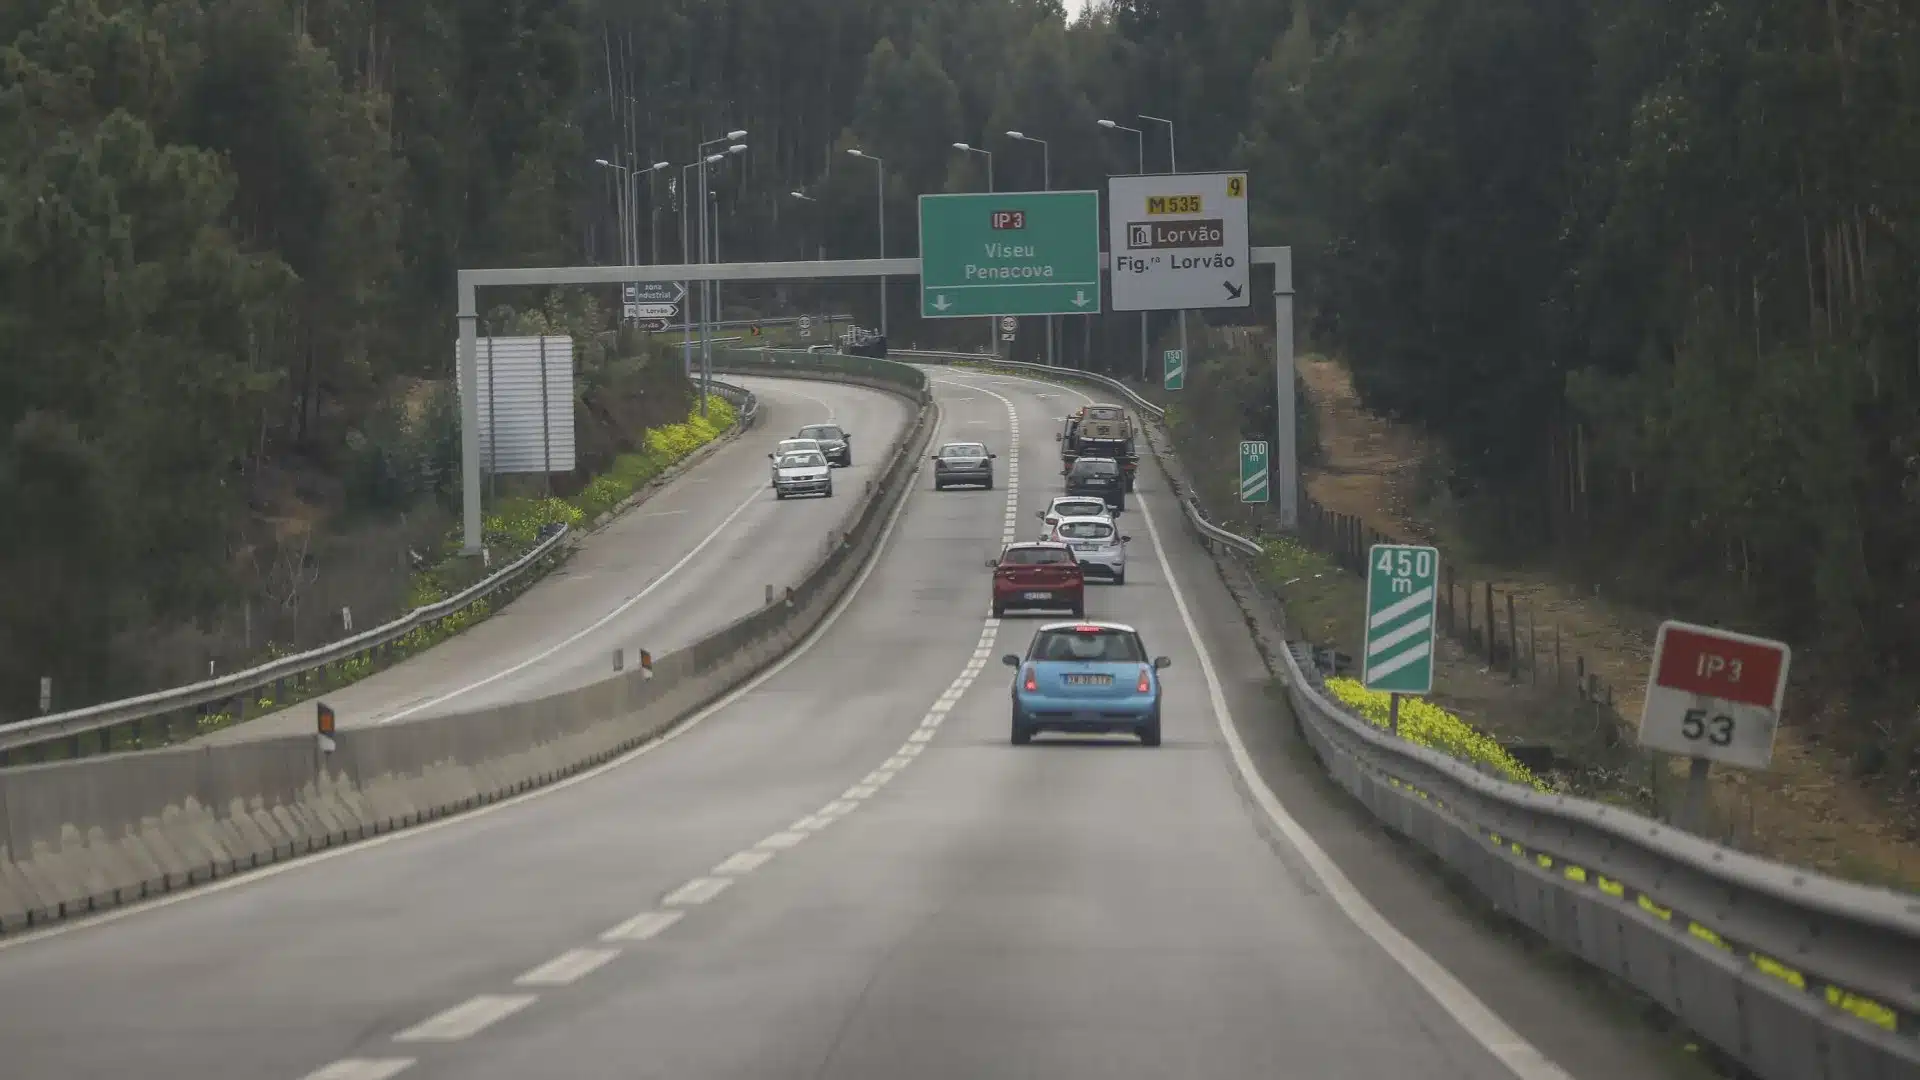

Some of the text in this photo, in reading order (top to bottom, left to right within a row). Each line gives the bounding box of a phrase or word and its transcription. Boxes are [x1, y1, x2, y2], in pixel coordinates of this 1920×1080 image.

[1229, 178, 1240, 197] 9
[1156, 225, 1221, 244] Lorvão
[984, 242, 1035, 258] Viseu
[1170, 253, 1236, 270] Lorvão
[965, 263, 1054, 280] Penacova
[1243, 443, 1265, 455] 300
[1249, 454, 1259, 462] m
[1376, 549, 1432, 578] 450
[1391, 576, 1413, 593] m
[1681, 707, 1736, 746] 53
